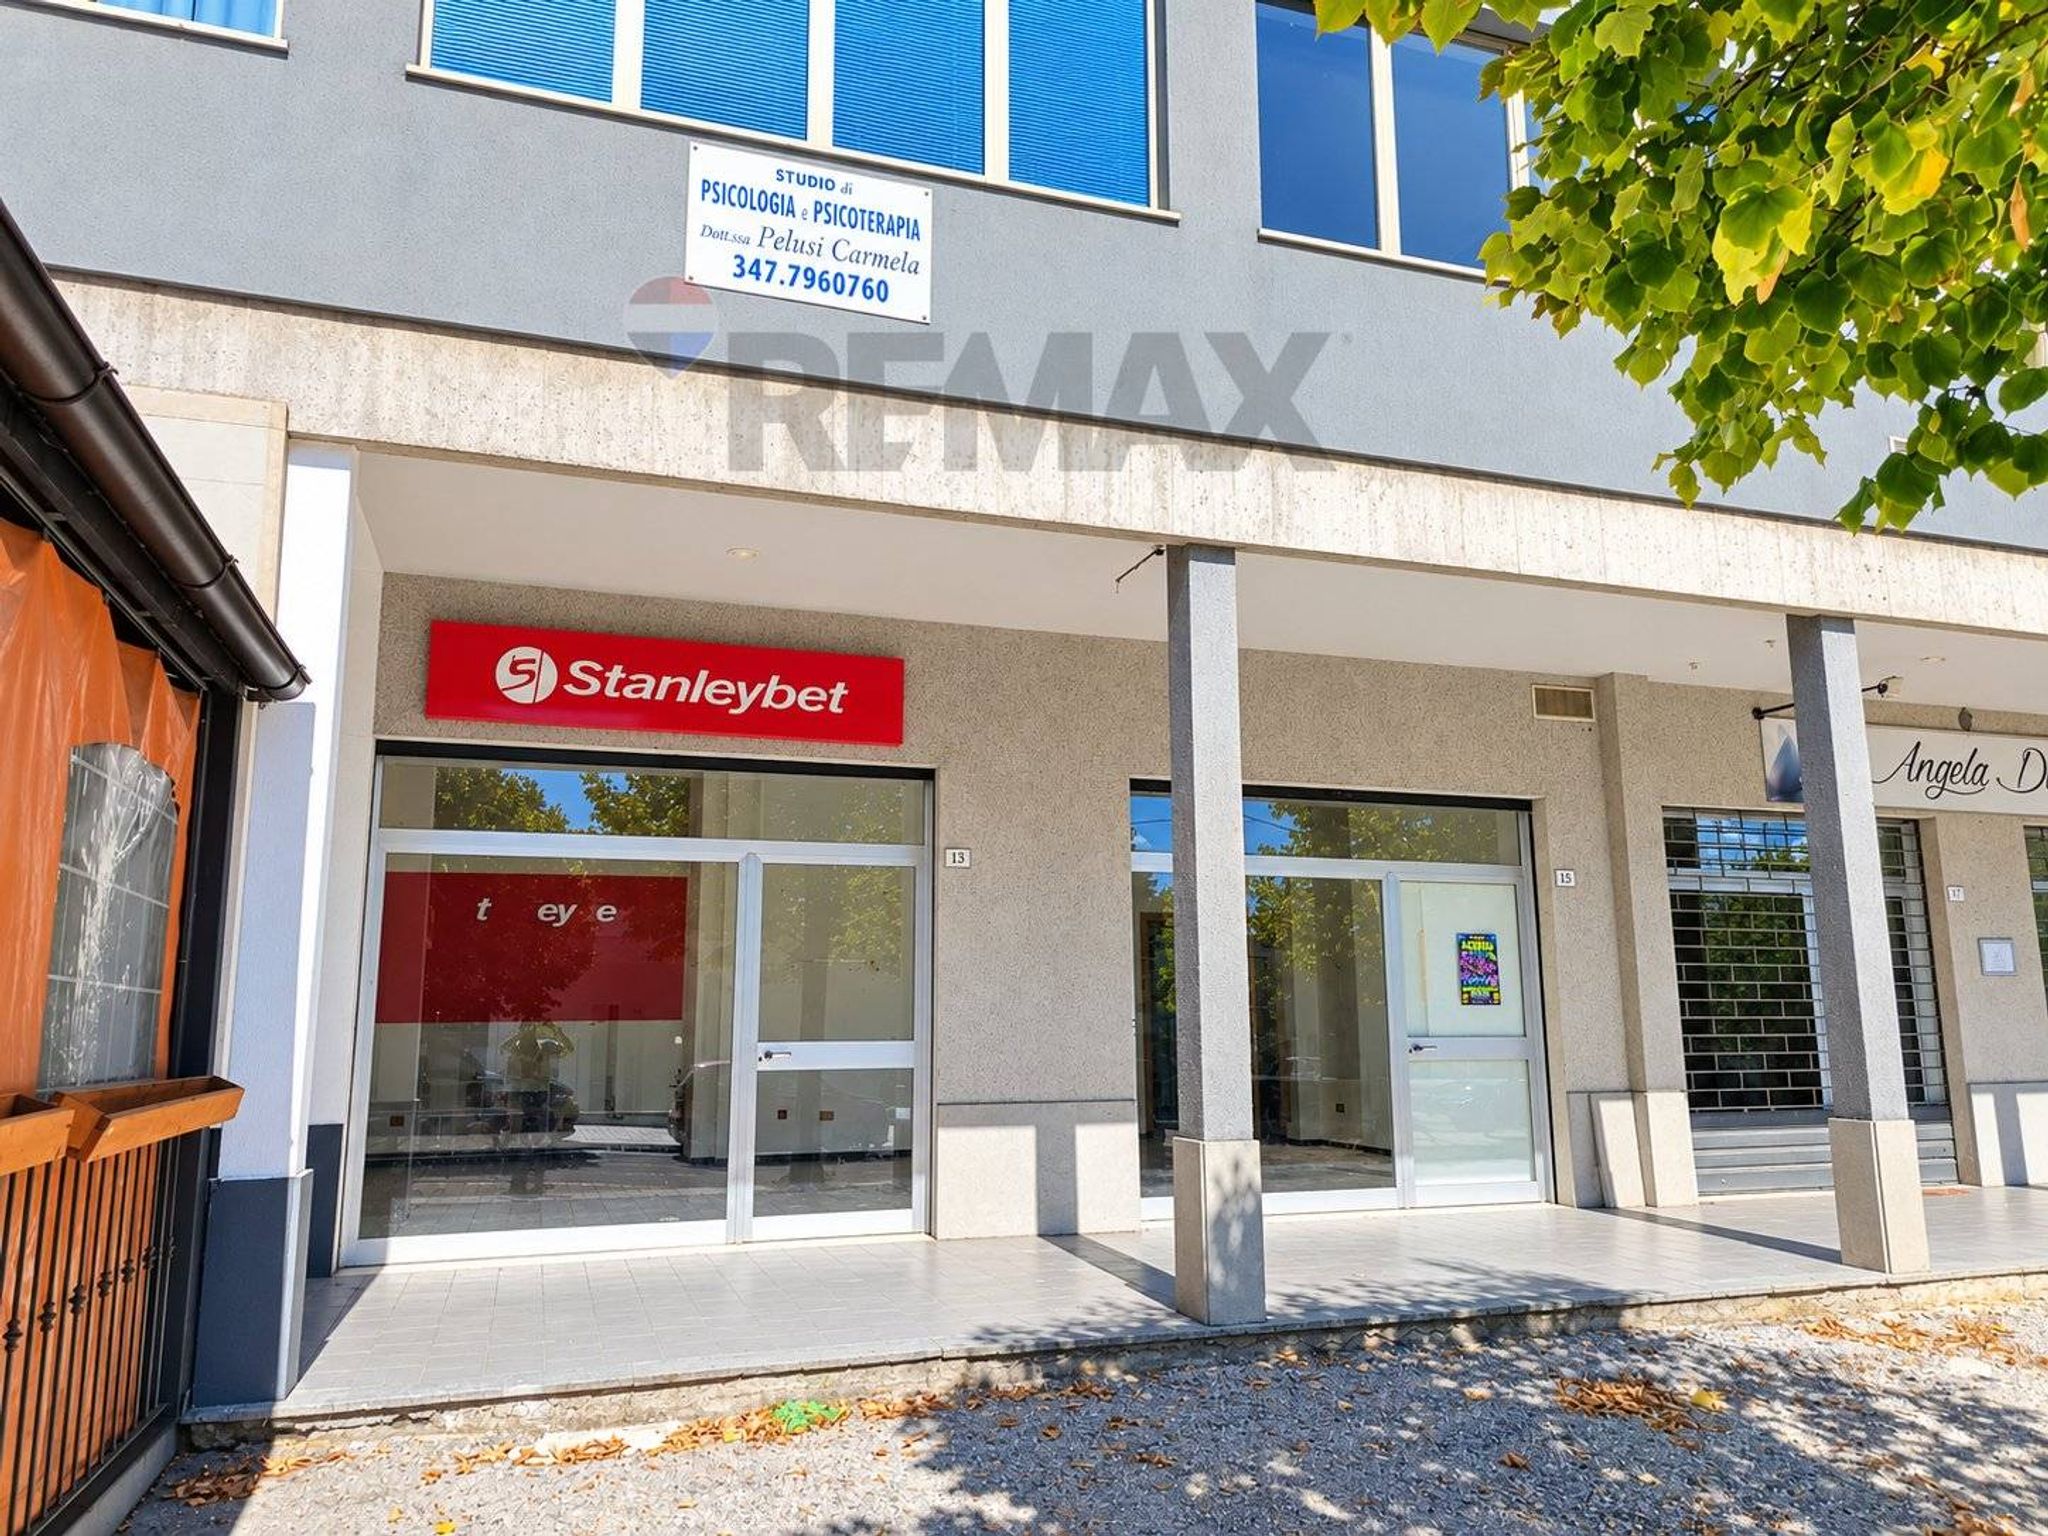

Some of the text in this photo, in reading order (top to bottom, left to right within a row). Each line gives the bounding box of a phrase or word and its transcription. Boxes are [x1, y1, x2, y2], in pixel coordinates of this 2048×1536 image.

[776, 169, 853, 195] STUDIO di
[701, 179, 921, 241] PSICOLOGIA e PSICOTERAPIA
[700, 224, 920, 275] Dott.ssa Pelusi Carmela
[733, 254, 889, 302] 347.7960760
[563, 660, 849, 715] Stanleybet
[1872, 741, 2048, 800] Angela D
[952, 851, 965, 864] 13
[1560, 872, 1572, 884] 15
